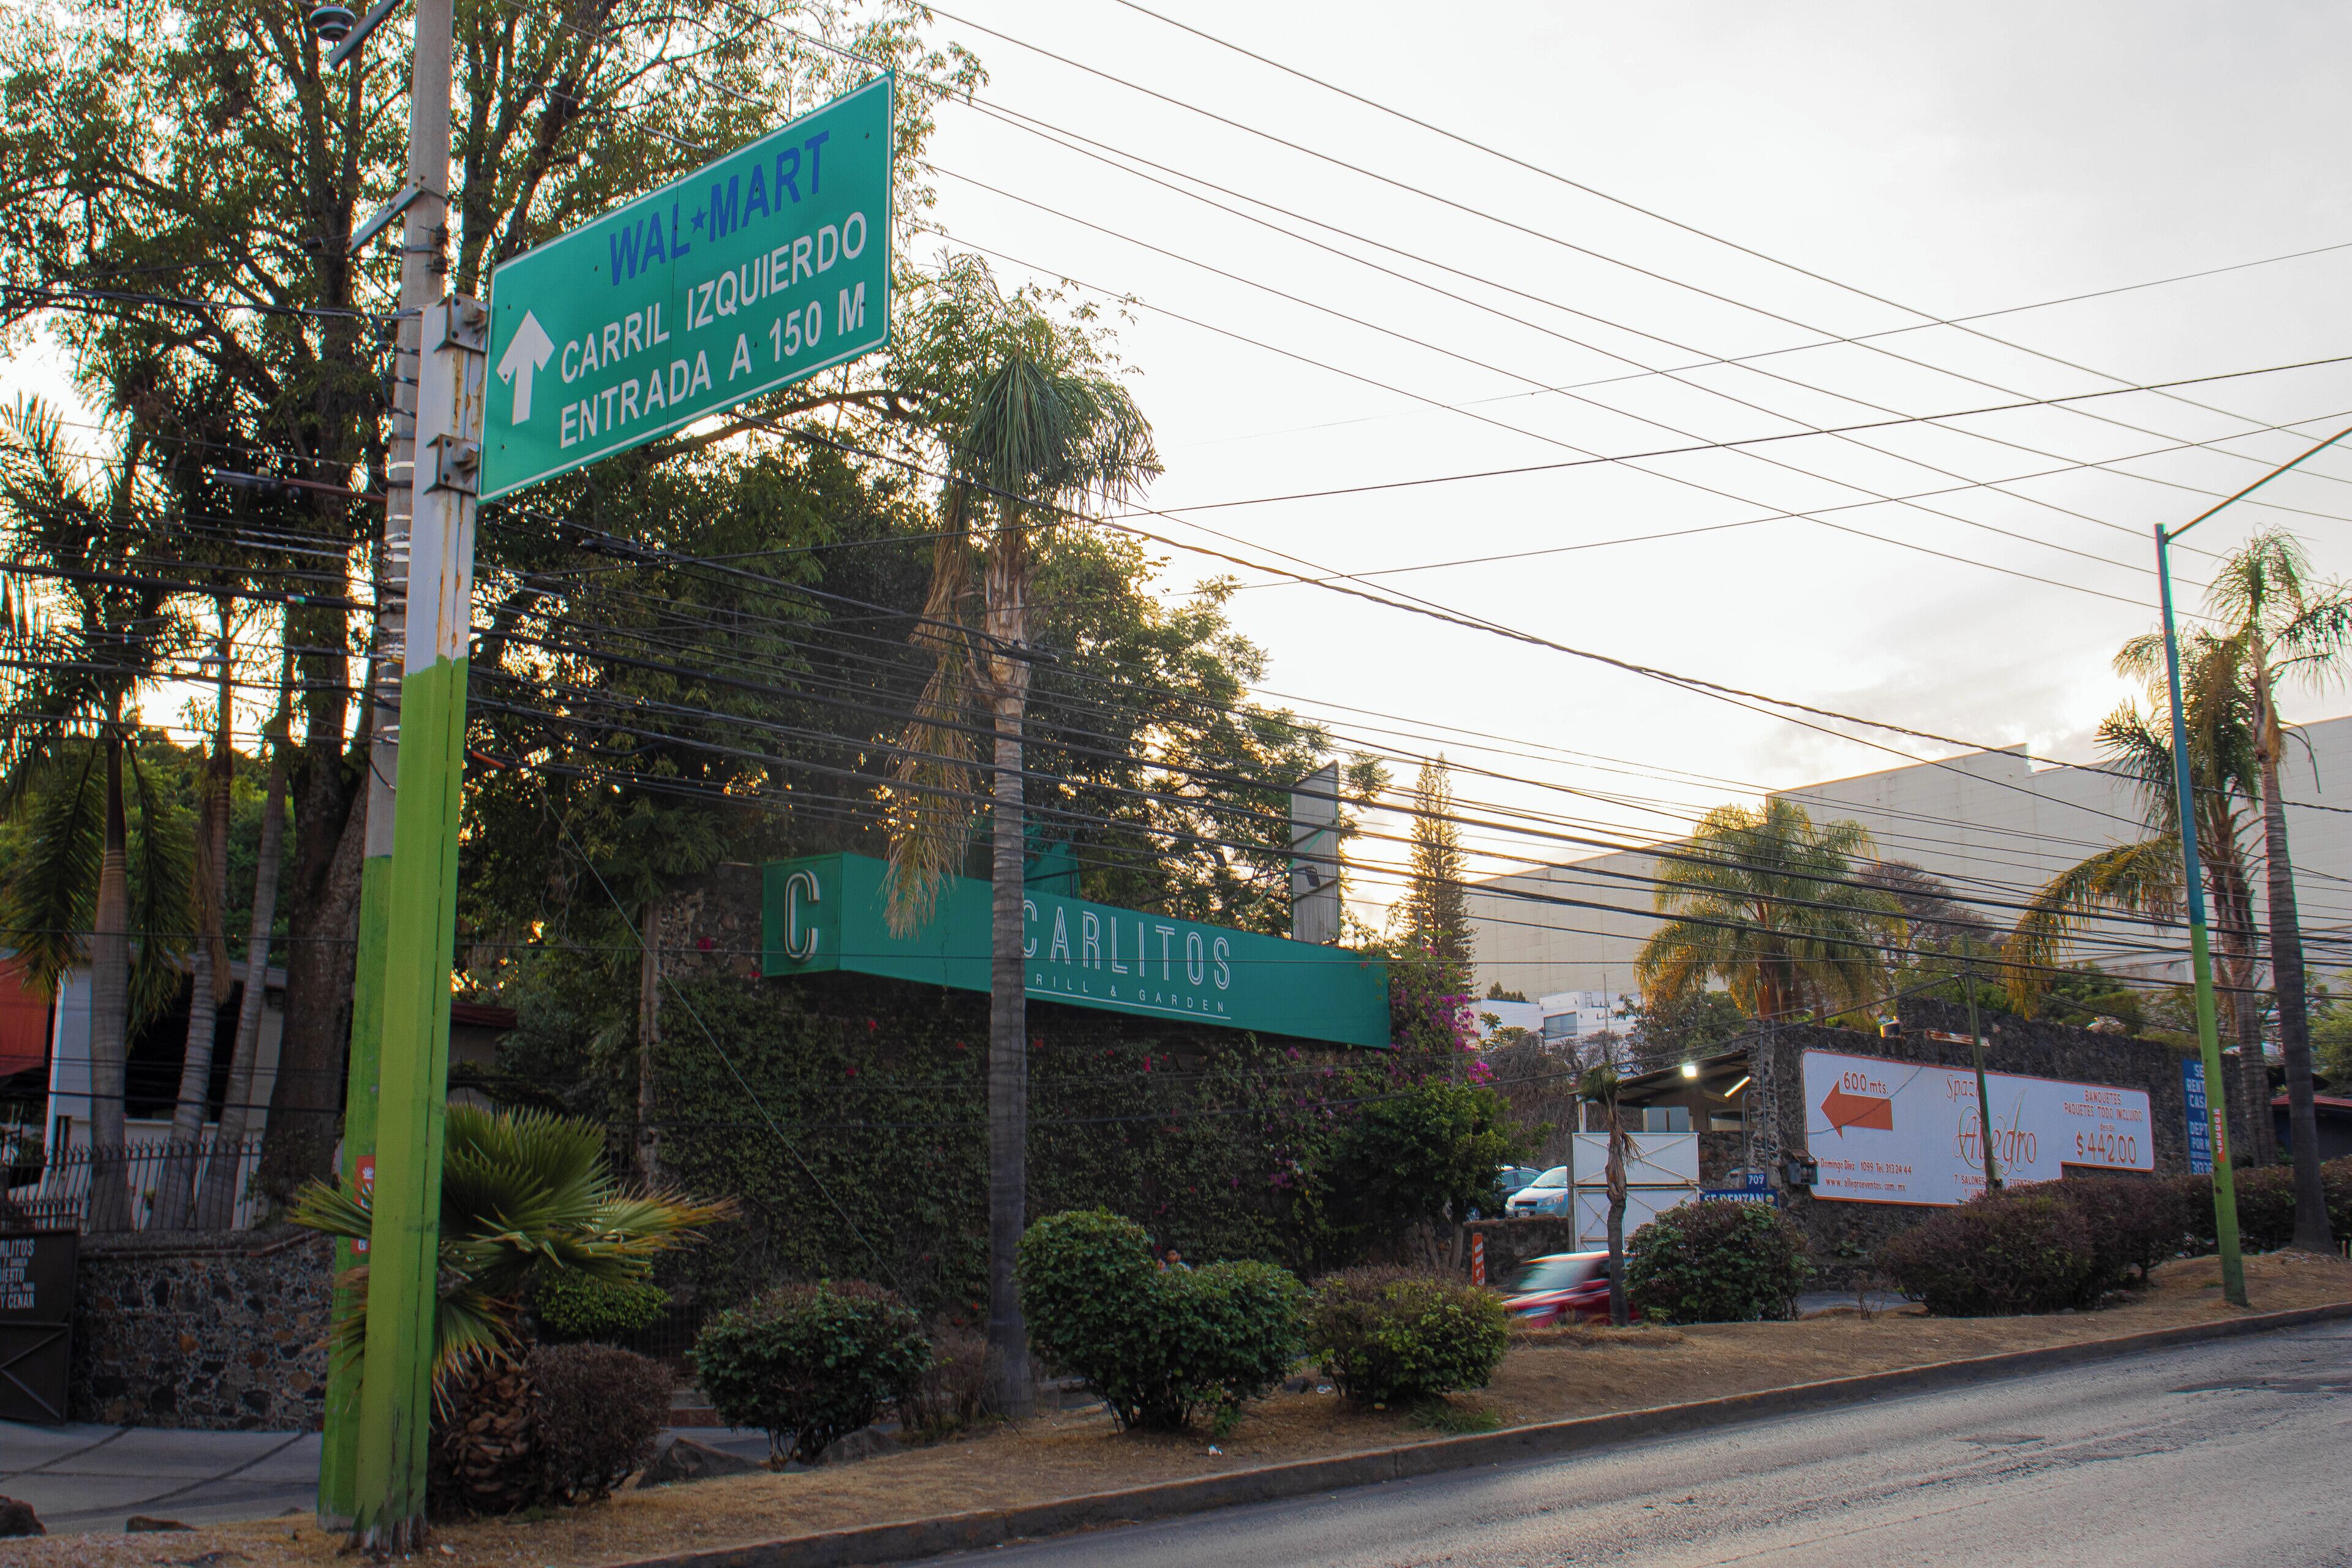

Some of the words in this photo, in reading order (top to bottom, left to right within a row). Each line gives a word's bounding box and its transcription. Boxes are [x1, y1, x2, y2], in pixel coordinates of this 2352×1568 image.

[561, 302, 671, 383] CARRIL
[686, 211, 868, 331] IZQUIERDO
[560, 350, 712, 449] ENTRADA
[728, 334, 753, 381] A
[769, 301, 822, 362] 150
[838, 281, 866, 336] M
[785, 869, 820, 962] C
[1023, 899, 1231, 990] CARLITOS
[1036, 973, 1088, 993] RILL
[1110, 985, 1117, 997] &
[1139, 989, 1224, 1013] GARDEN
[1844, 1071, 1867, 1091] 600
[1869, 1078, 1888, 1094] mts.
[2085, 1089, 2122, 1105] BANQUETES
[2064, 1101, 2095, 1117] PAQUETES
[2097, 1106, 2113, 1119] TODO
[2116, 1107, 2143, 1122] INCLUIDO
[1961, 1175, 1986, 1186] SALONES
